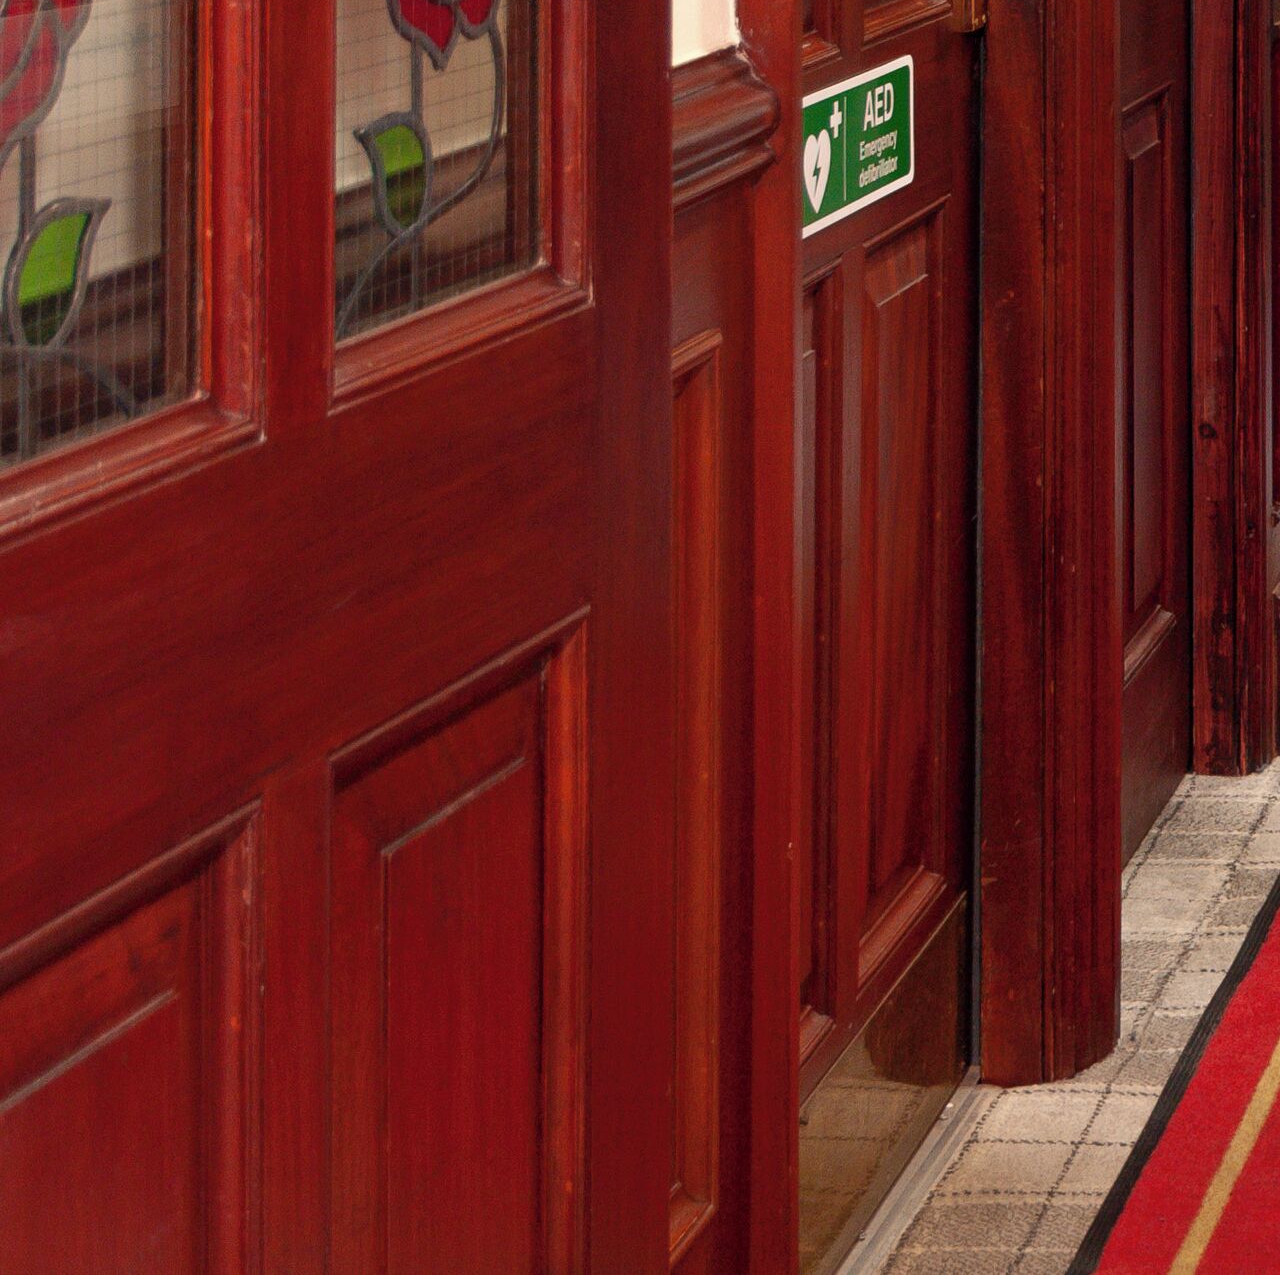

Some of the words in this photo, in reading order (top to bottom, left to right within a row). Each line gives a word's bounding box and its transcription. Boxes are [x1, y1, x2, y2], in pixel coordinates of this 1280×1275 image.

[863, 81, 895, 132] AED
[859, 130, 898, 161] Emergency
[859, 156, 898, 188] defibrillator
